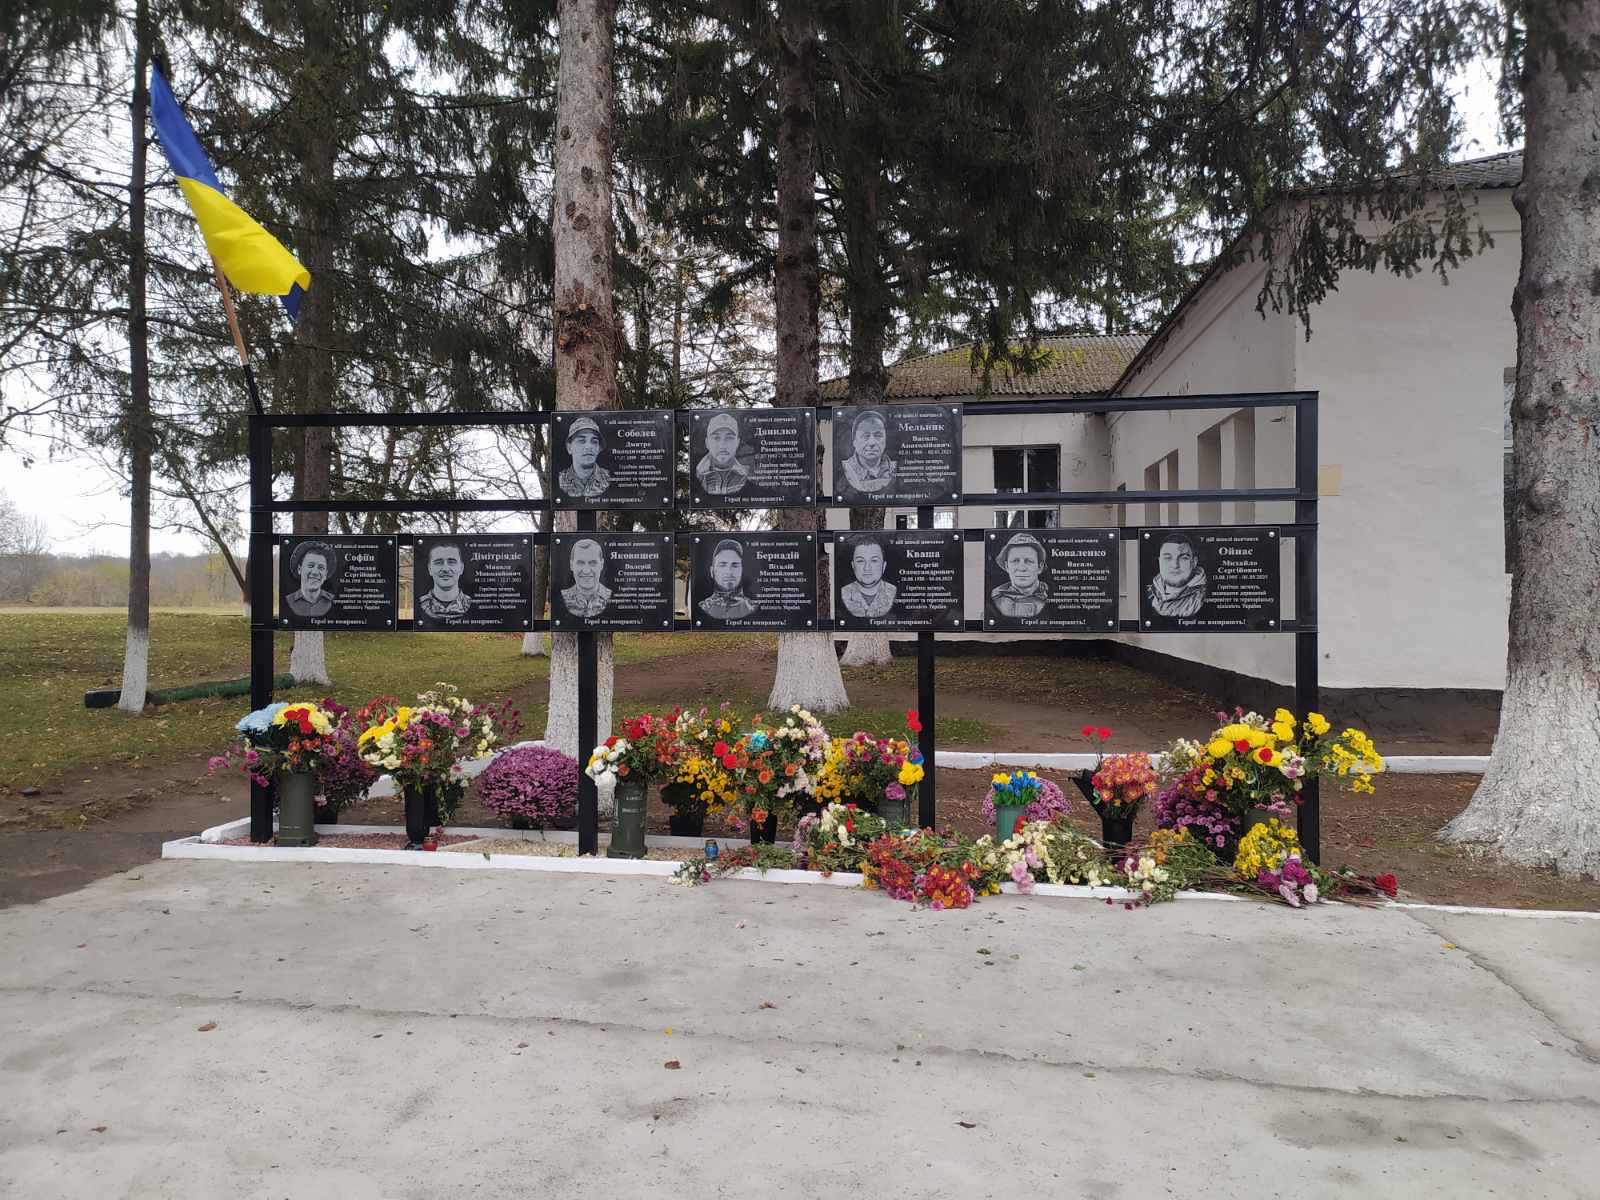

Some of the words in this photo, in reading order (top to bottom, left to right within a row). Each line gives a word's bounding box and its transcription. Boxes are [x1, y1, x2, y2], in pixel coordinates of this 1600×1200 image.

[899, 423, 944, 431] Мельник
[907, 550, 940, 558] Кваша
[1052, 549, 1106, 557] Коваленко
[1219, 547, 1253, 555] Ойнас
